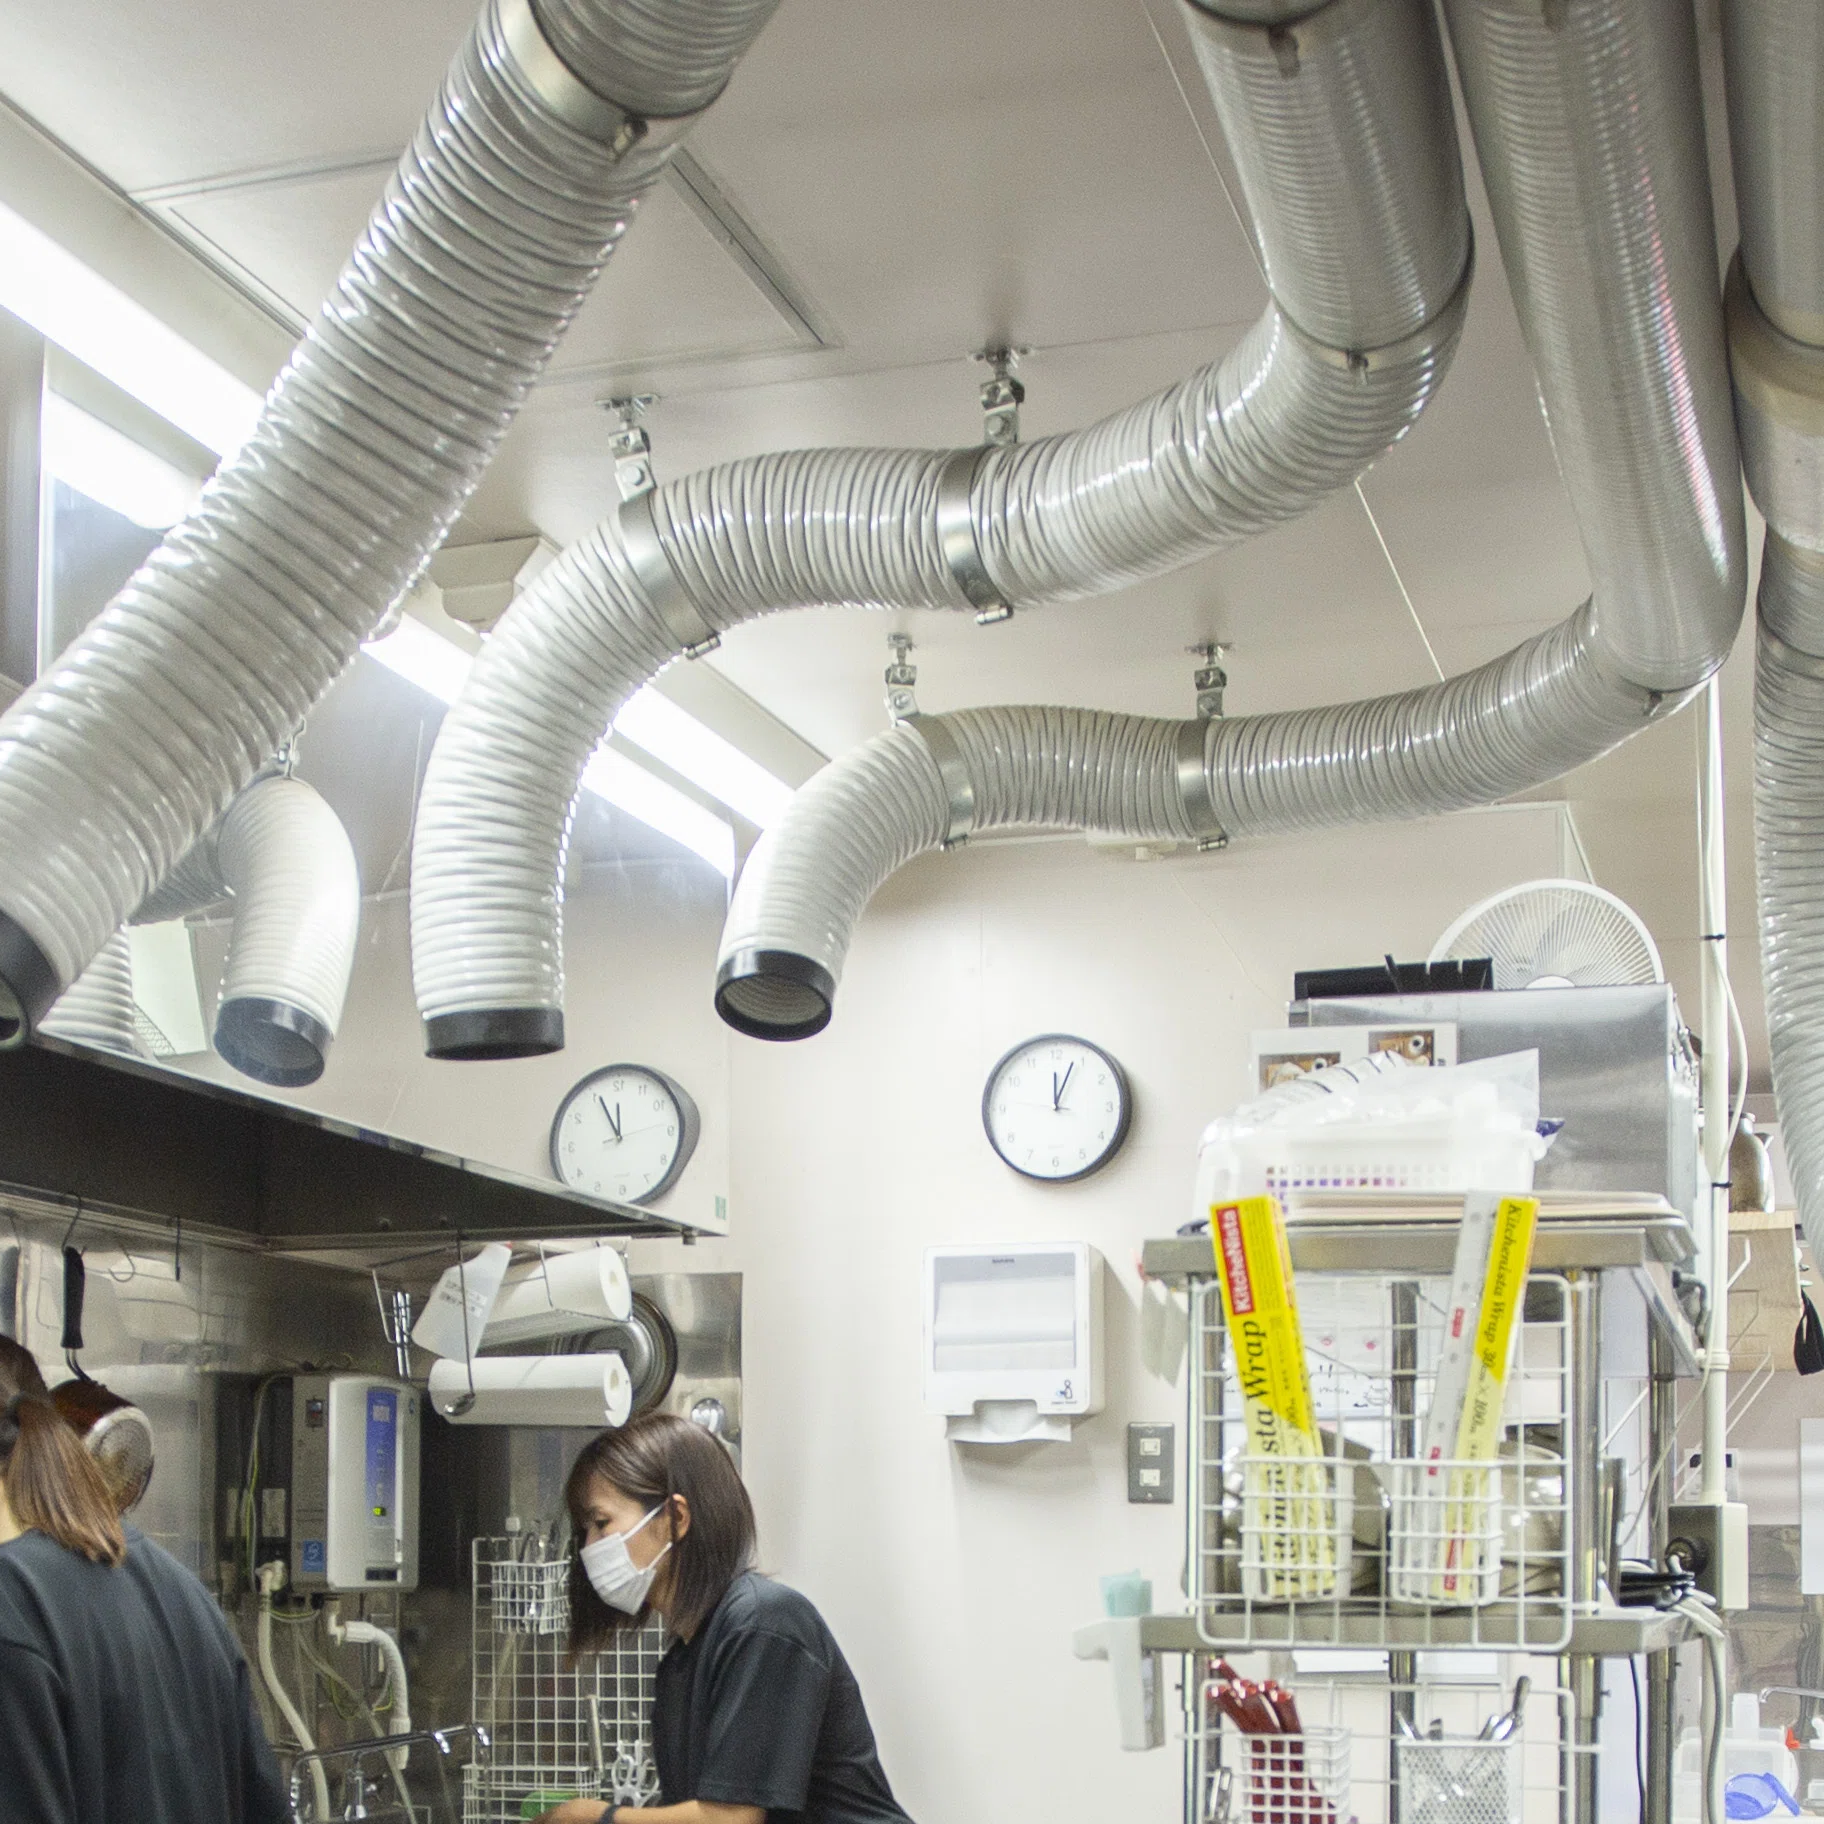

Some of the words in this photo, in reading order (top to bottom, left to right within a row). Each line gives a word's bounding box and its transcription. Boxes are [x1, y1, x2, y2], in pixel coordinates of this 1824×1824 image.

[1494, 1203, 1522, 1297] Kitchenista
[1243, 1320, 1270, 1401] Wrap
[1483, 1301, 1505, 1343] Wrap
